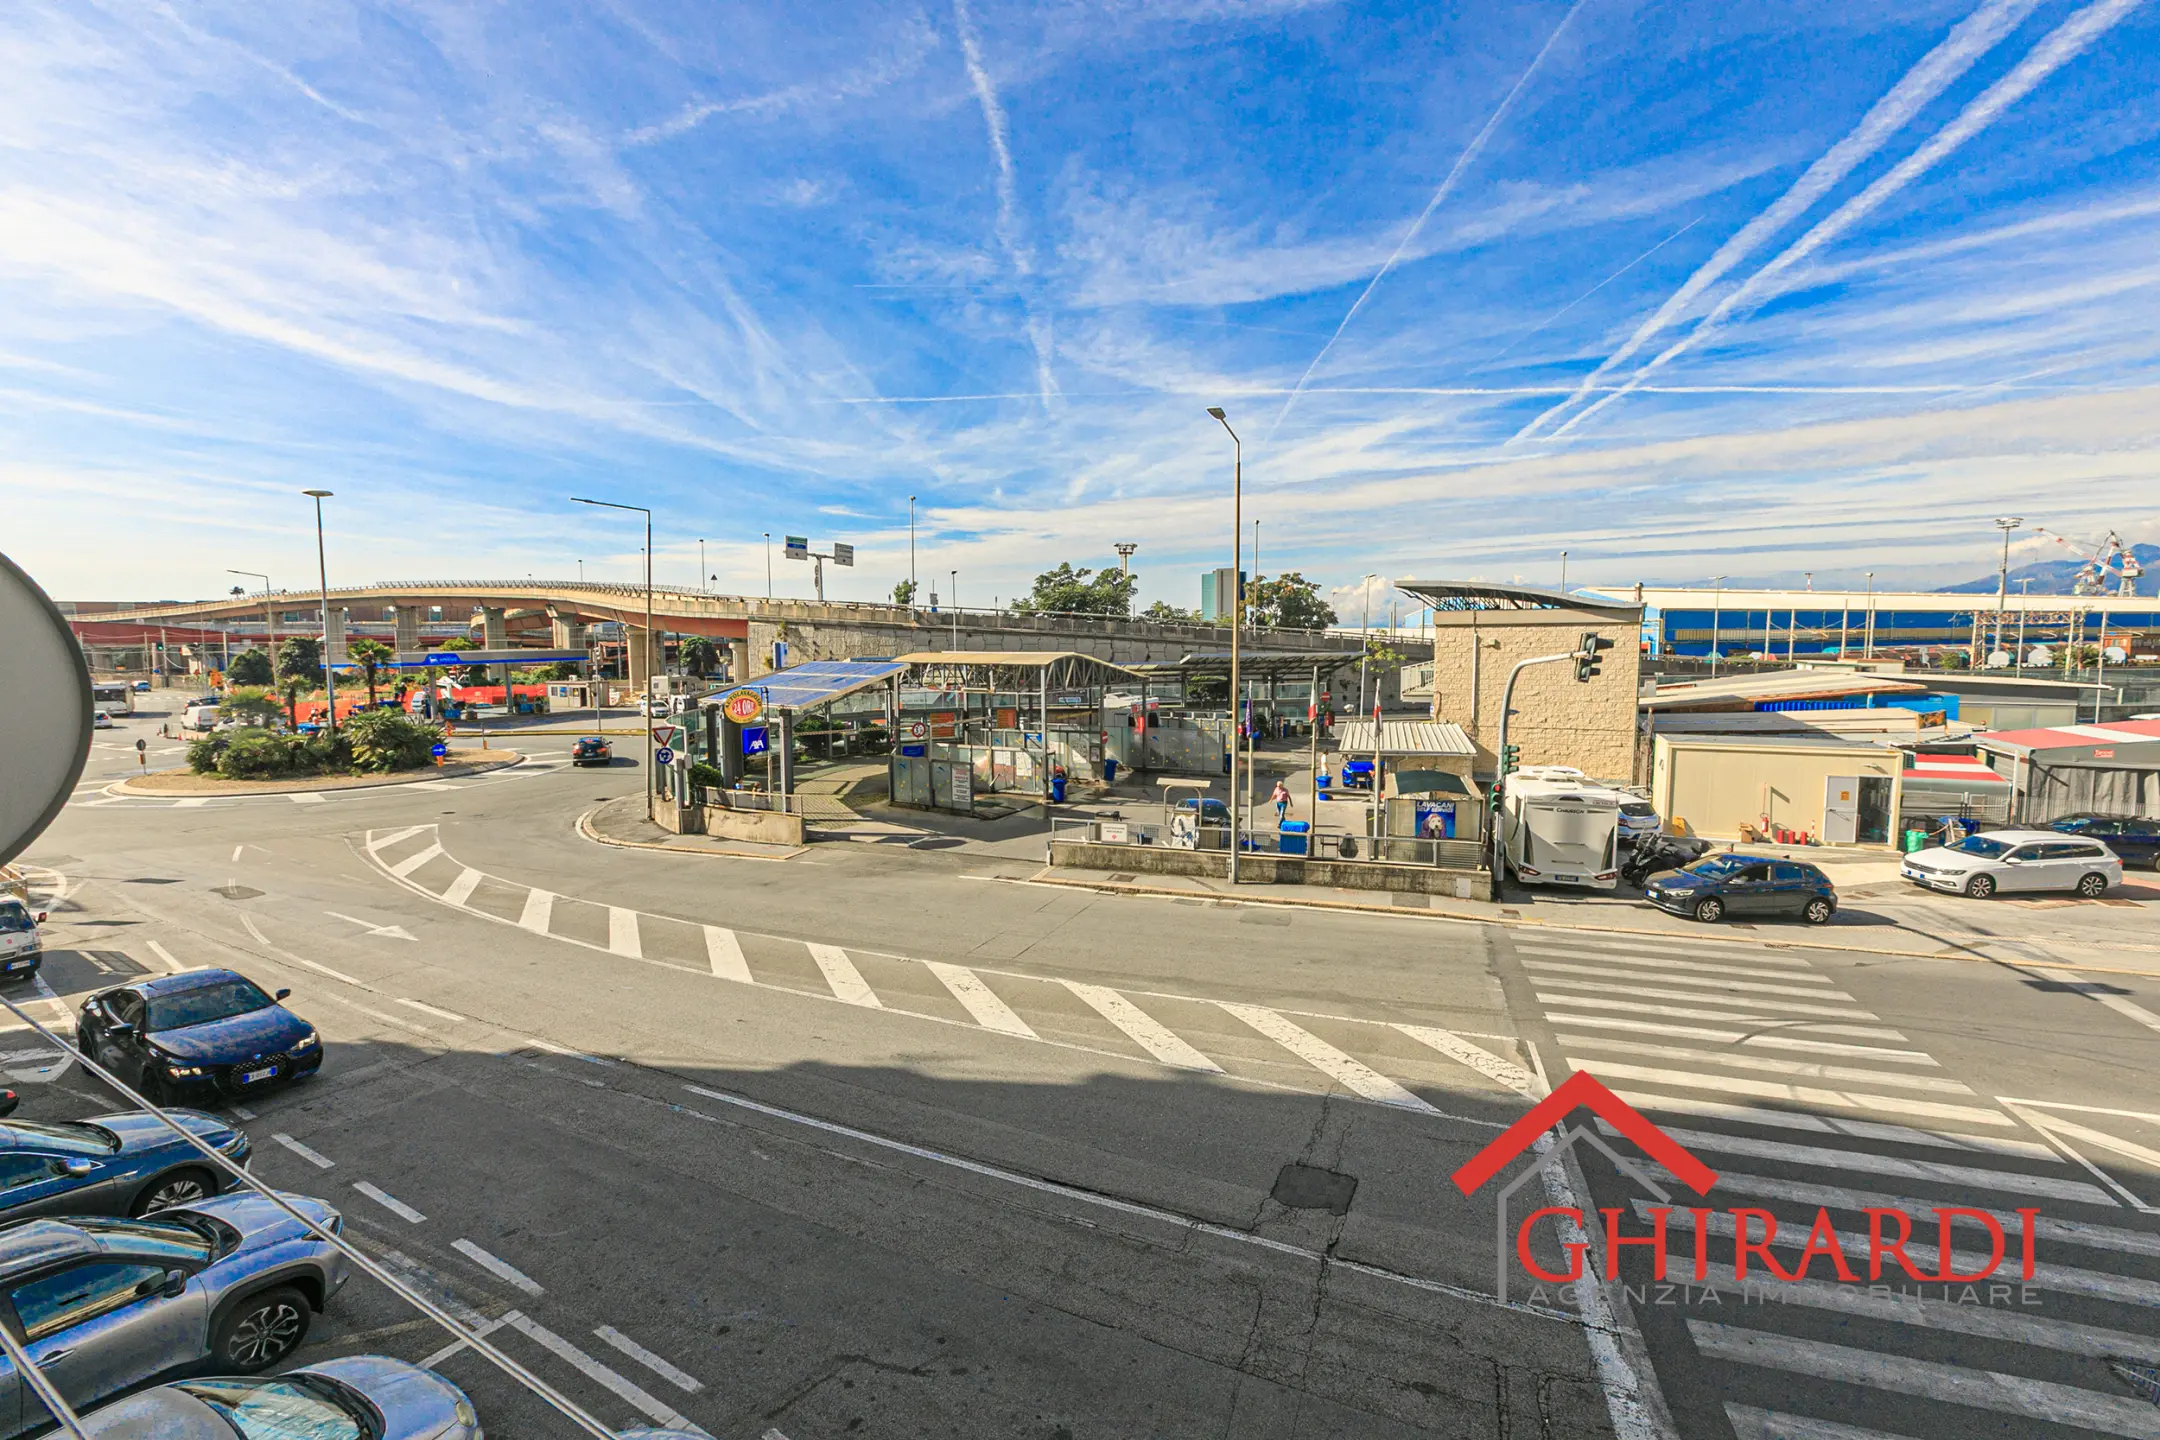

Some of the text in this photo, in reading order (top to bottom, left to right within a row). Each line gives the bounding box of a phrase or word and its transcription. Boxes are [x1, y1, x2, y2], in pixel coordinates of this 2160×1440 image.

[734, 702, 741, 714] 24
[749, 739, 764, 751] AXA
[1416, 801, 1454, 809] LAVACANI
